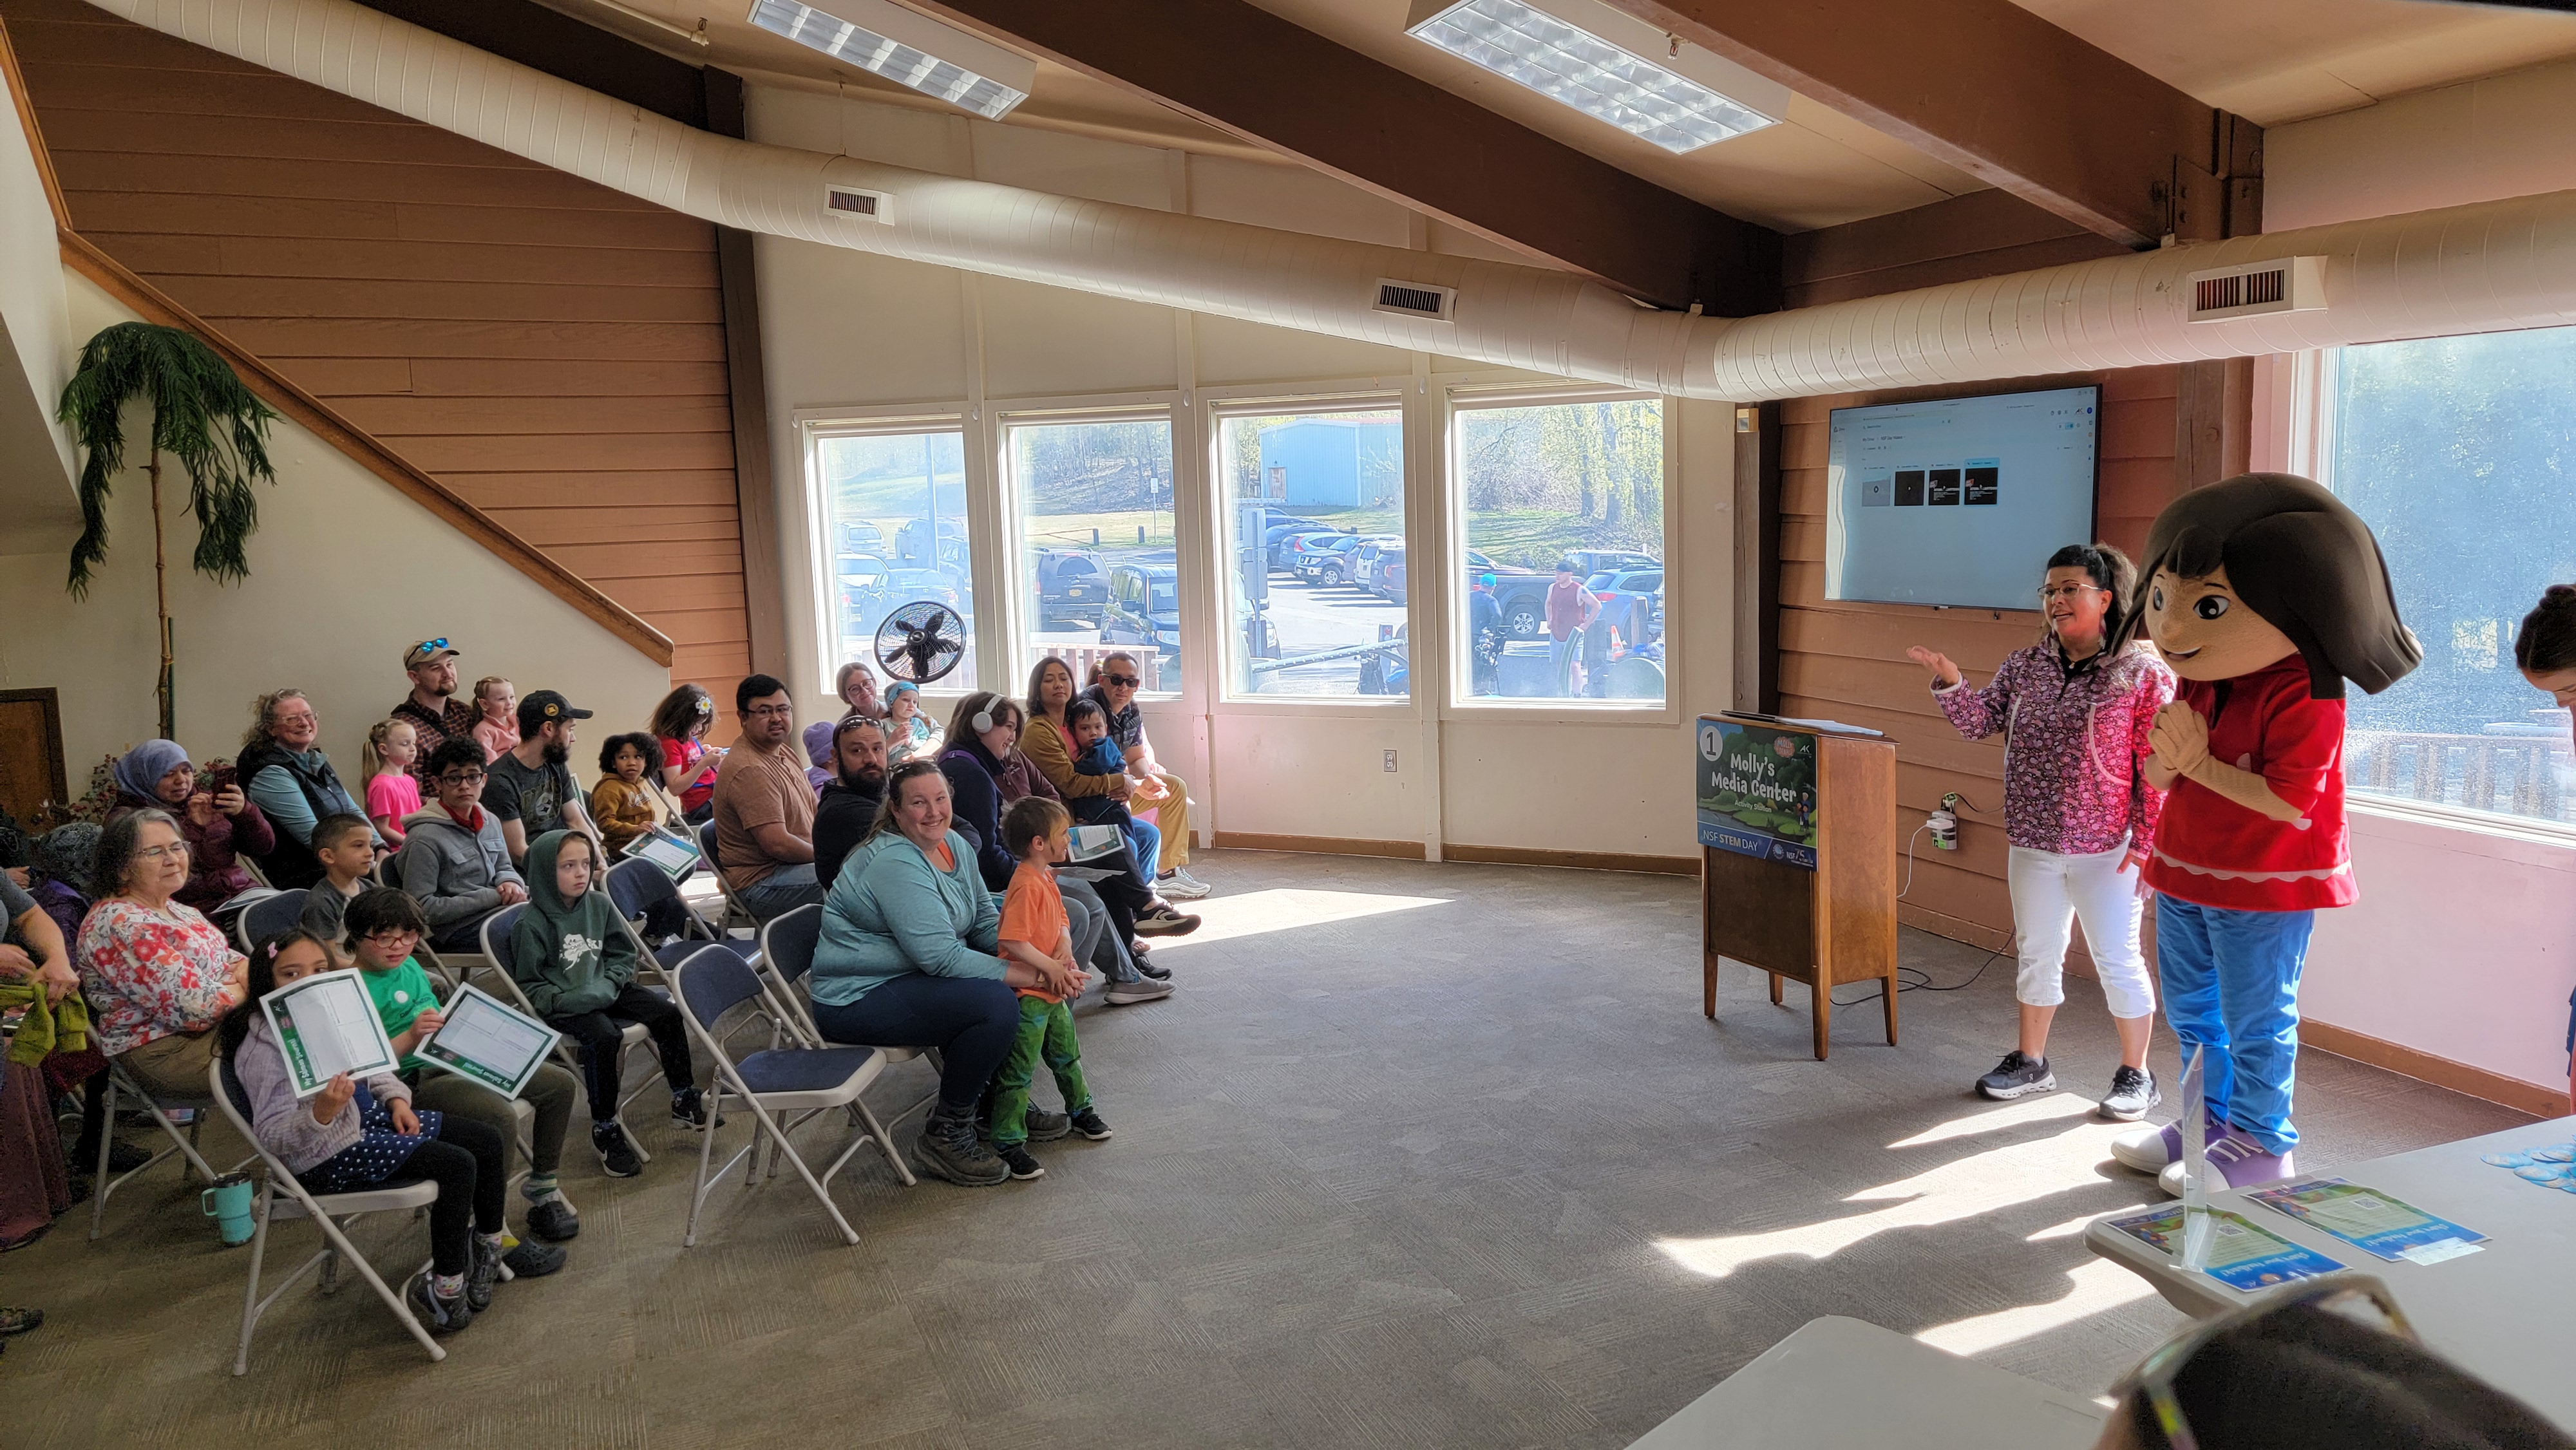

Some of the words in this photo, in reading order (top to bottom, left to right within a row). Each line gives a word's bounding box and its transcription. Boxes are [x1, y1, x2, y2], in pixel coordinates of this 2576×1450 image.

[1707, 731, 1716, 756] 1
[1800, 745, 1810, 753] AK
[1730, 753, 1775, 781] Molly's
[1712, 771, 1747, 794] Media
[1752, 780, 1797, 802] Center
[1734, 800, 1753, 810] Activity
[1754, 804, 1772, 813] Station
[1703, 830, 1718, 842] NSF
[1719, 834, 1741, 847] STEM
[1742, 839, 1758, 851] DAY
[1786, 851, 1795, 860] NSF
[287, 1038, 303, 1060] Journal
[299, 1059, 310, 1078] Salmon
[462, 1062, 484, 1074] Journal
[304, 1078, 313, 1086] My
[484, 1071, 502, 1084] Salmon
[502, 1080, 511, 1088] My
